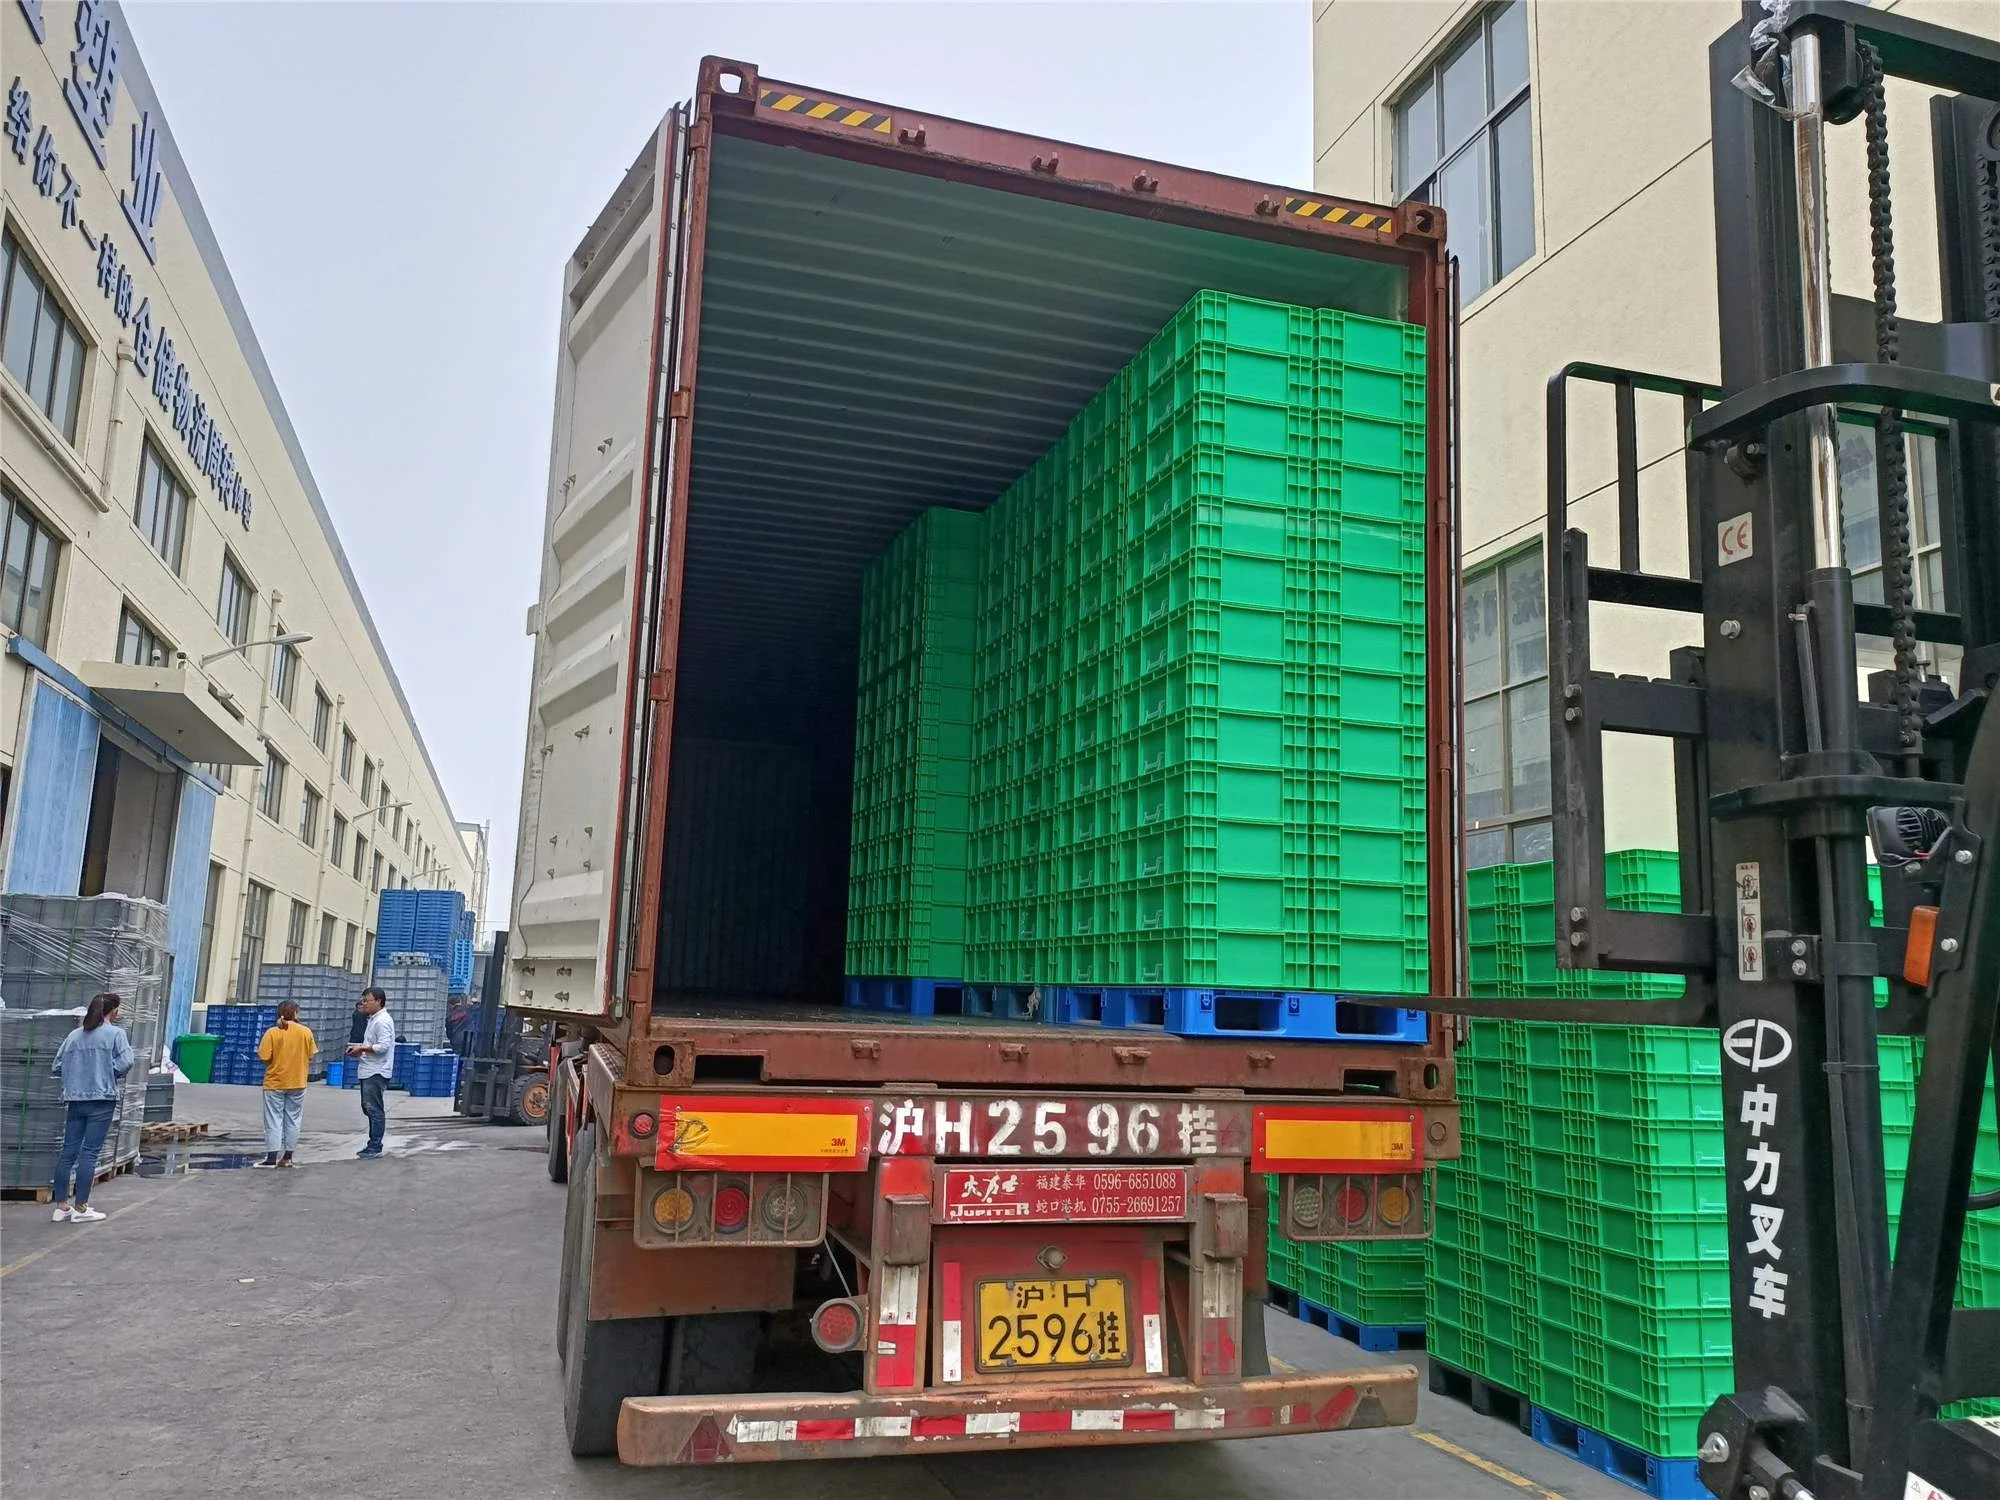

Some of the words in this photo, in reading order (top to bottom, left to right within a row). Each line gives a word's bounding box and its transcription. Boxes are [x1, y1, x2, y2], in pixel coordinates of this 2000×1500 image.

[1721, 520, 1749, 557] CE
[831, 1137, 847, 1147] 3M
[1391, 1142, 1404, 1151] 3M
[1036, 1174, 1087, 1191] 福建泰华
[1093, 1172, 1177, 1191] 0596-6851088
[1035, 1198, 1087, 1215] 蛇口港机
[1091, 1196, 1182, 1214] 0755-26691257
[1740, 1084, 1789, 1319] 中力叉车
[988, 1311, 1121, 1361] 2596挂
